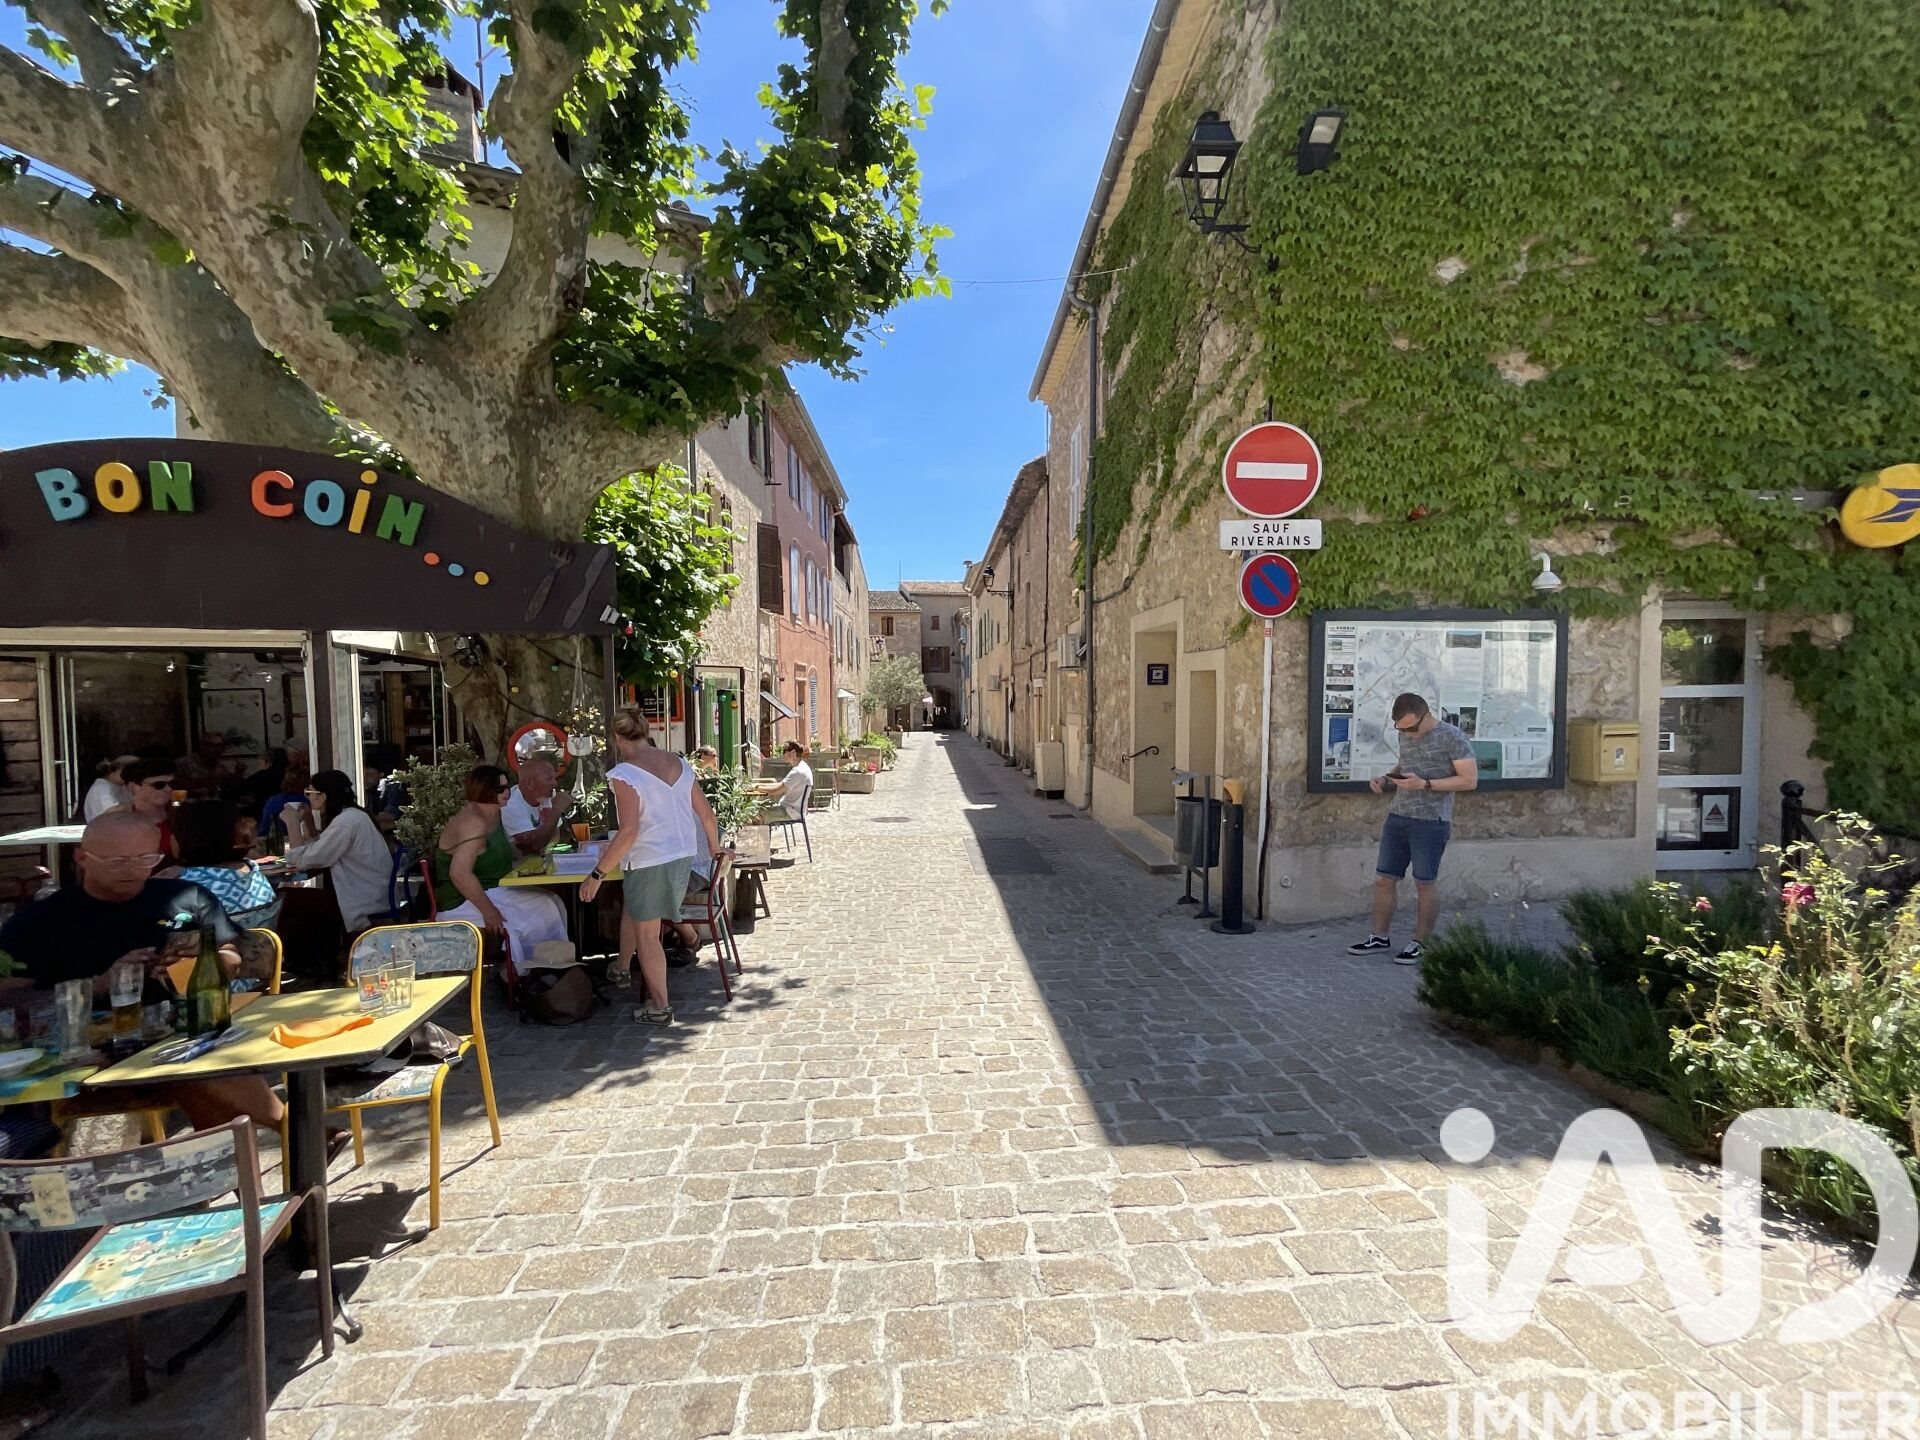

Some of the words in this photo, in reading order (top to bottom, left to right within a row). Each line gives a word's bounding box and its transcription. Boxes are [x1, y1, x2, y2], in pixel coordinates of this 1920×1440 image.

[35, 460, 195, 522] BON
[1253, 523, 1290, 534] SAUF
[1231, 536, 1311, 546] RIVERAINS
